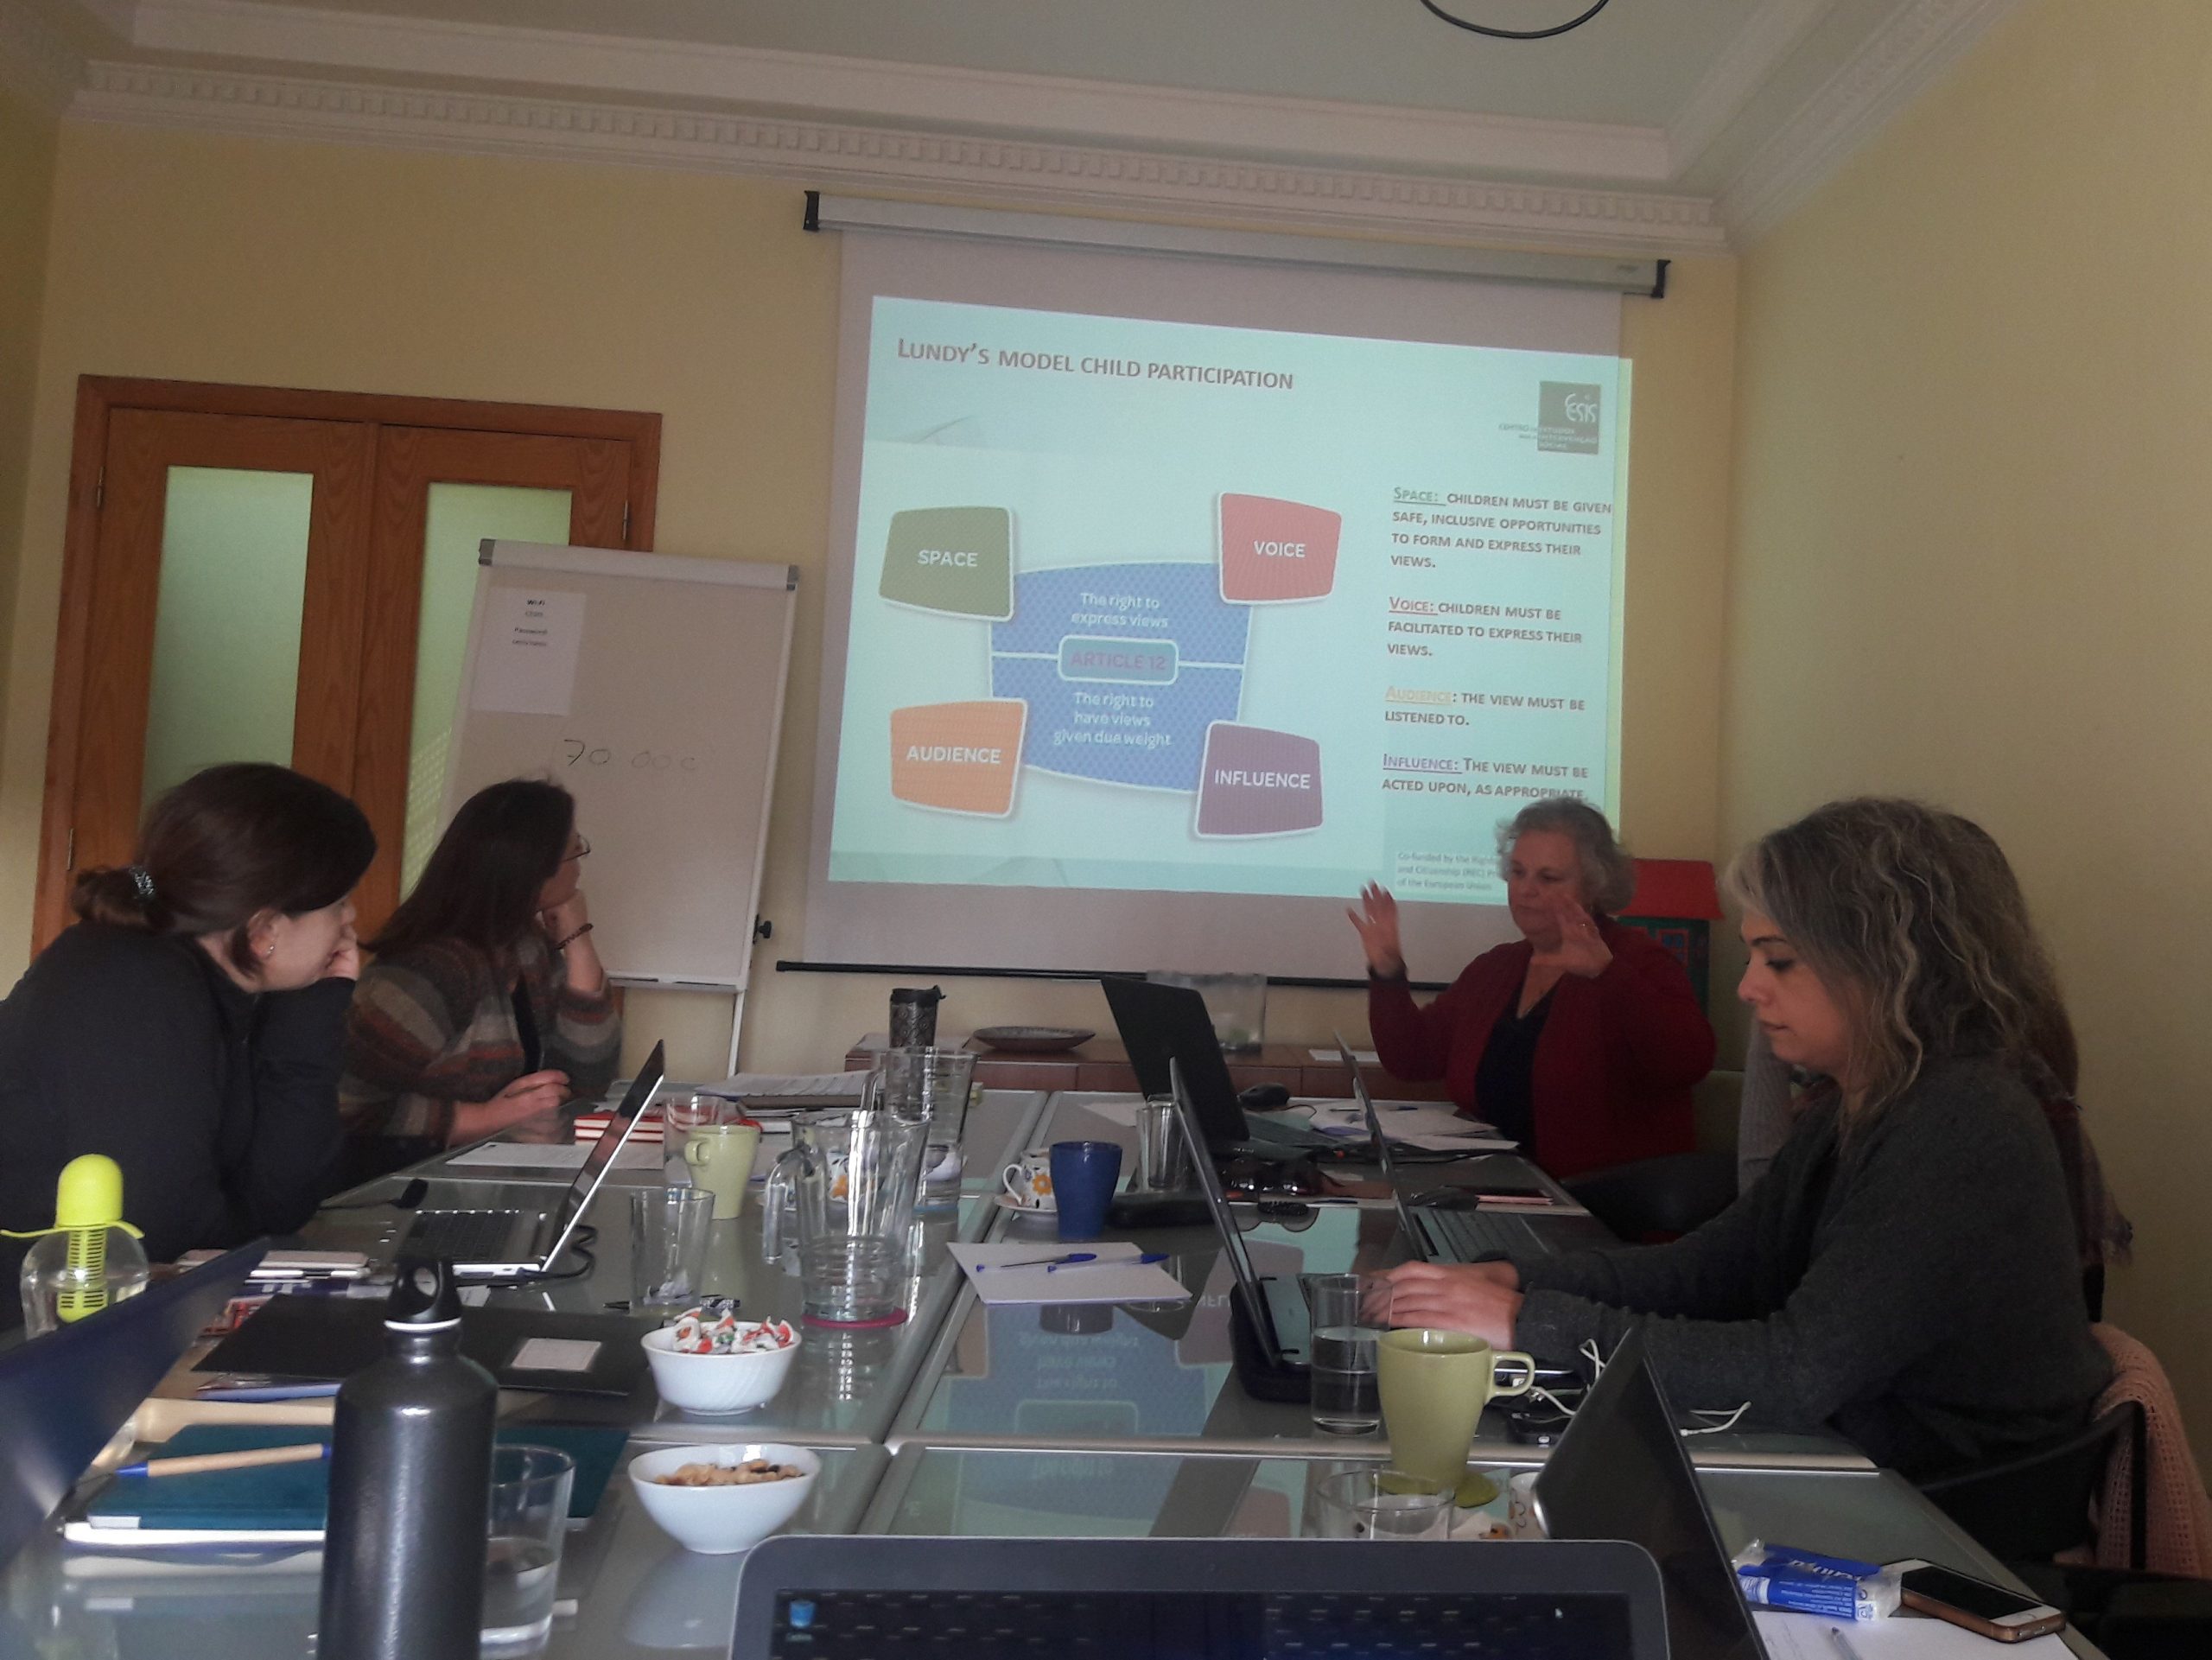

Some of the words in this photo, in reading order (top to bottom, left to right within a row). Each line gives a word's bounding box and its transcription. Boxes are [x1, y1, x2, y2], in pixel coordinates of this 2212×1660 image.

[897, 338, 990, 365] LUNDY'S
[998, 351, 1075, 372] MODEL
[1080, 356, 1141, 378] CHILD
[1147, 363, 1294, 390] PARTICIPATION
[1393, 487, 1439, 502] SPACE:
[1446, 493, 1509, 507] CHILDREN
[1512, 498, 1549, 510] MUST
[1553, 500, 1569, 512] BE
[1573, 501, 1612, 513] GIVEN
[1392, 512, 1427, 525] SAFE,
[1431, 514, 1496, 528] INCLUSIVE
[1499, 518, 1601, 535] OPPORTUNITIES
[1253, 540, 1306, 558] VOICE
[1391, 533, 1409, 544] TO
[1413, 534, 1451, 547] FORM
[1455, 537, 1484, 549] AND
[1488, 540, 1542, 553] EXPRESS
[1545, 543, 1581, 556] THEIR
[918, 549, 978, 568] SPACE
[1390, 555, 1436, 568] VIEWS.
[1080, 592, 1106, 605] The
[1109, 595, 1141, 610] right
[1145, 598, 1160, 608] to
[1389, 596, 1434, 612] VOICE:
[1438, 602, 1500, 616] CHILDREN
[1505, 607, 1542, 619] MUST
[1546, 609, 1561, 620] BE
[1071, 613, 1128, 627] express
[1129, 614, 1169, 628] views
[1389, 620, 1464, 636] FACILITATED
[1467, 626, 1484, 637] TO
[1489, 627, 1542, 641] EXPRESS
[1546, 631, 1582, 643] THEIR
[1388, 643, 1433, 657] VIEWS.
[1070, 650, 1143, 670] ARTICLE
[1149, 655, 1166, 671] 12
[1074, 692, 1100, 705] The
[1103, 694, 1136, 709] right
[1139, 696, 1154, 707] to
[1461, 693, 1485, 704] THE
[1491, 695, 1524, 707] VIEW
[1528, 696, 1565, 709] MUST
[1569, 699, 1585, 710] BE
[1074, 711, 1110, 725] have
[1111, 711, 1151, 726] views
[1385, 711, 1445, 724] LISTENED
[1448, 715, 1470, 725] TO.
[1052, 728, 1092, 745] given
[1095, 730, 1122, 744] due
[1124, 732, 1171, 748] weight
[563, 739, 612, 766] 70
[906, 745, 1001, 765] AUDIENCE
[1382, 754, 1459, 770] INFLUENCE:
[1463, 757, 1489, 772] THE
[1493, 763, 1528, 774] VIEW
[1531, 765, 1568, 776] MUST
[1573, 766, 1588, 778] BE
[1214, 768, 1311, 790] INFLUENCE
[1382, 779, 1424, 792] ACTED
[1428, 781, 1471, 796] UPON,
[1475, 785, 1491, 795] AS
